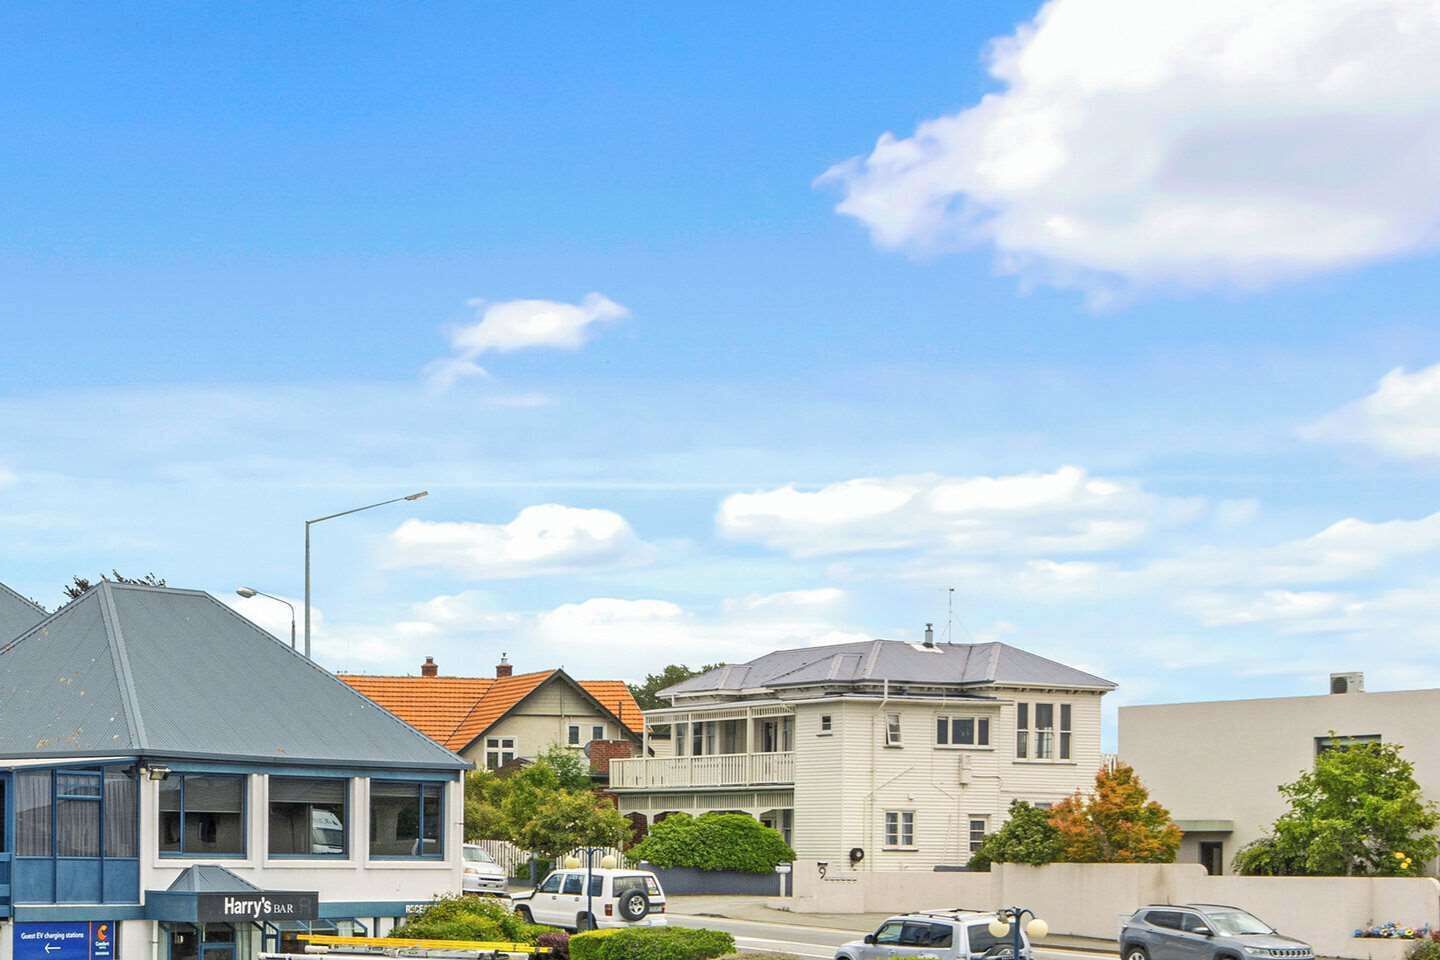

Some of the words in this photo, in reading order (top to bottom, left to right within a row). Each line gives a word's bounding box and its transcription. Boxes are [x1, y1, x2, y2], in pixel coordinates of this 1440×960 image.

[224, 896, 272, 918] Harry's
[273, 903, 294, 913] BAR
[44, 932, 65, 941] charging
